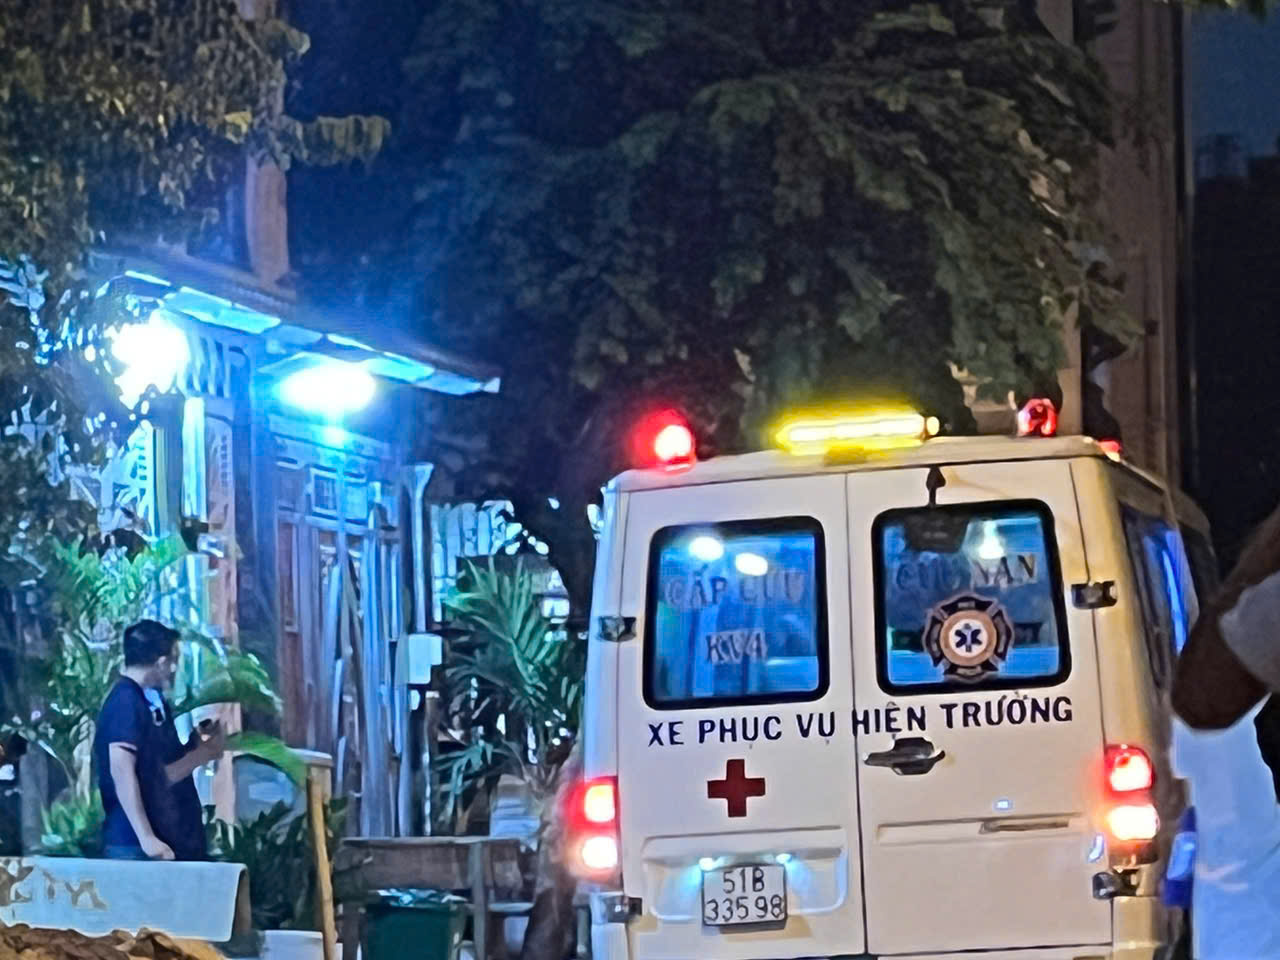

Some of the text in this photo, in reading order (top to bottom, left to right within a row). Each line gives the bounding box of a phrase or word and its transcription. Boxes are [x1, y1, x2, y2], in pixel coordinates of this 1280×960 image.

[648, 720, 685, 747] XE
[698, 715, 783, 749] PHỤC
[795, 711, 836, 745] VỤ
[939, 690, 1073, 729] TRƯỜNG
[723, 866, 765, 894] 51B
[704, 894, 784, 922] 33598
